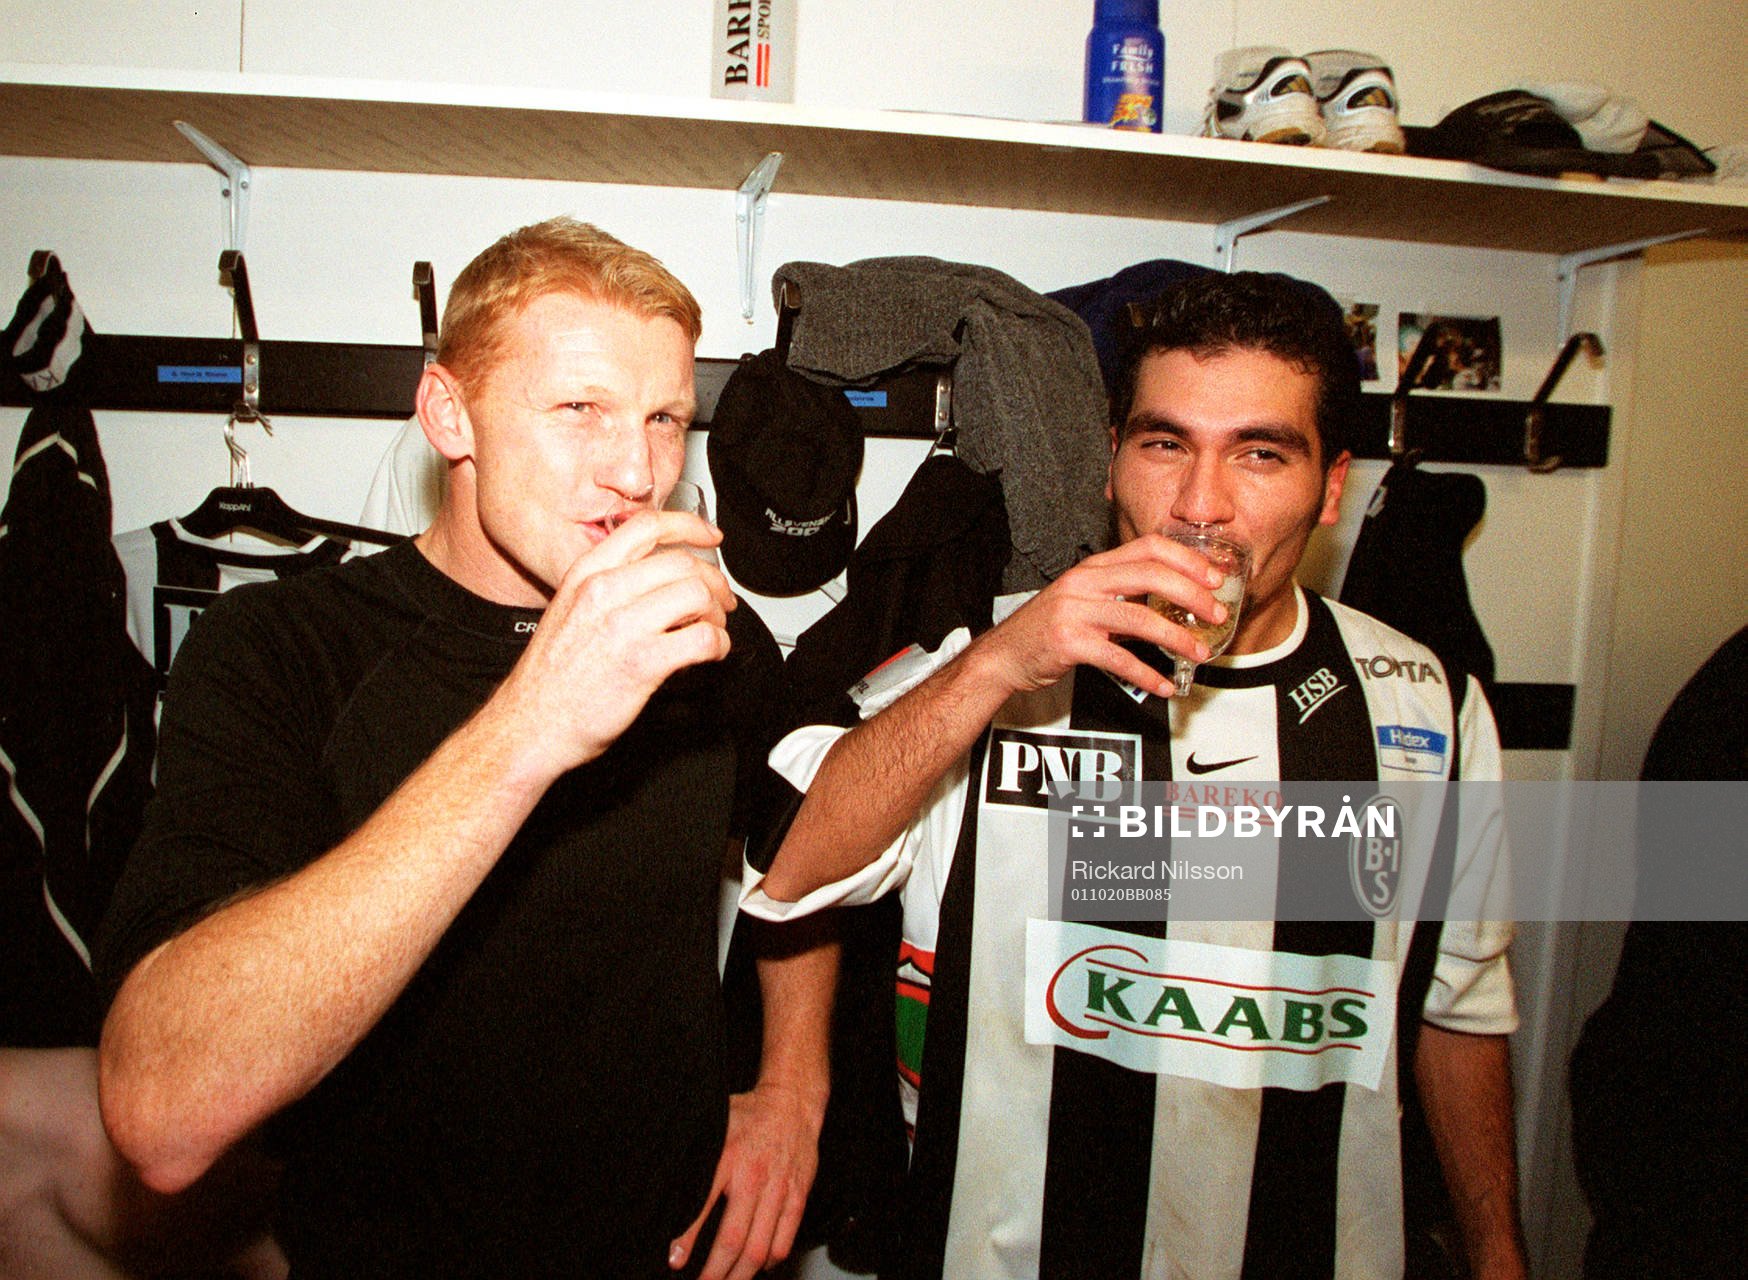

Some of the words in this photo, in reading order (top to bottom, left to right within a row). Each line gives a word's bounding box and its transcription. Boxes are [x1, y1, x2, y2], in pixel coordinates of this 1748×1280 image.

[1288, 667, 1338, 712] HSB
[996, 740, 1123, 802] PNB
[1165, 781, 1284, 810] BAREKO
[1086, 969, 1369, 1045] KAABS
